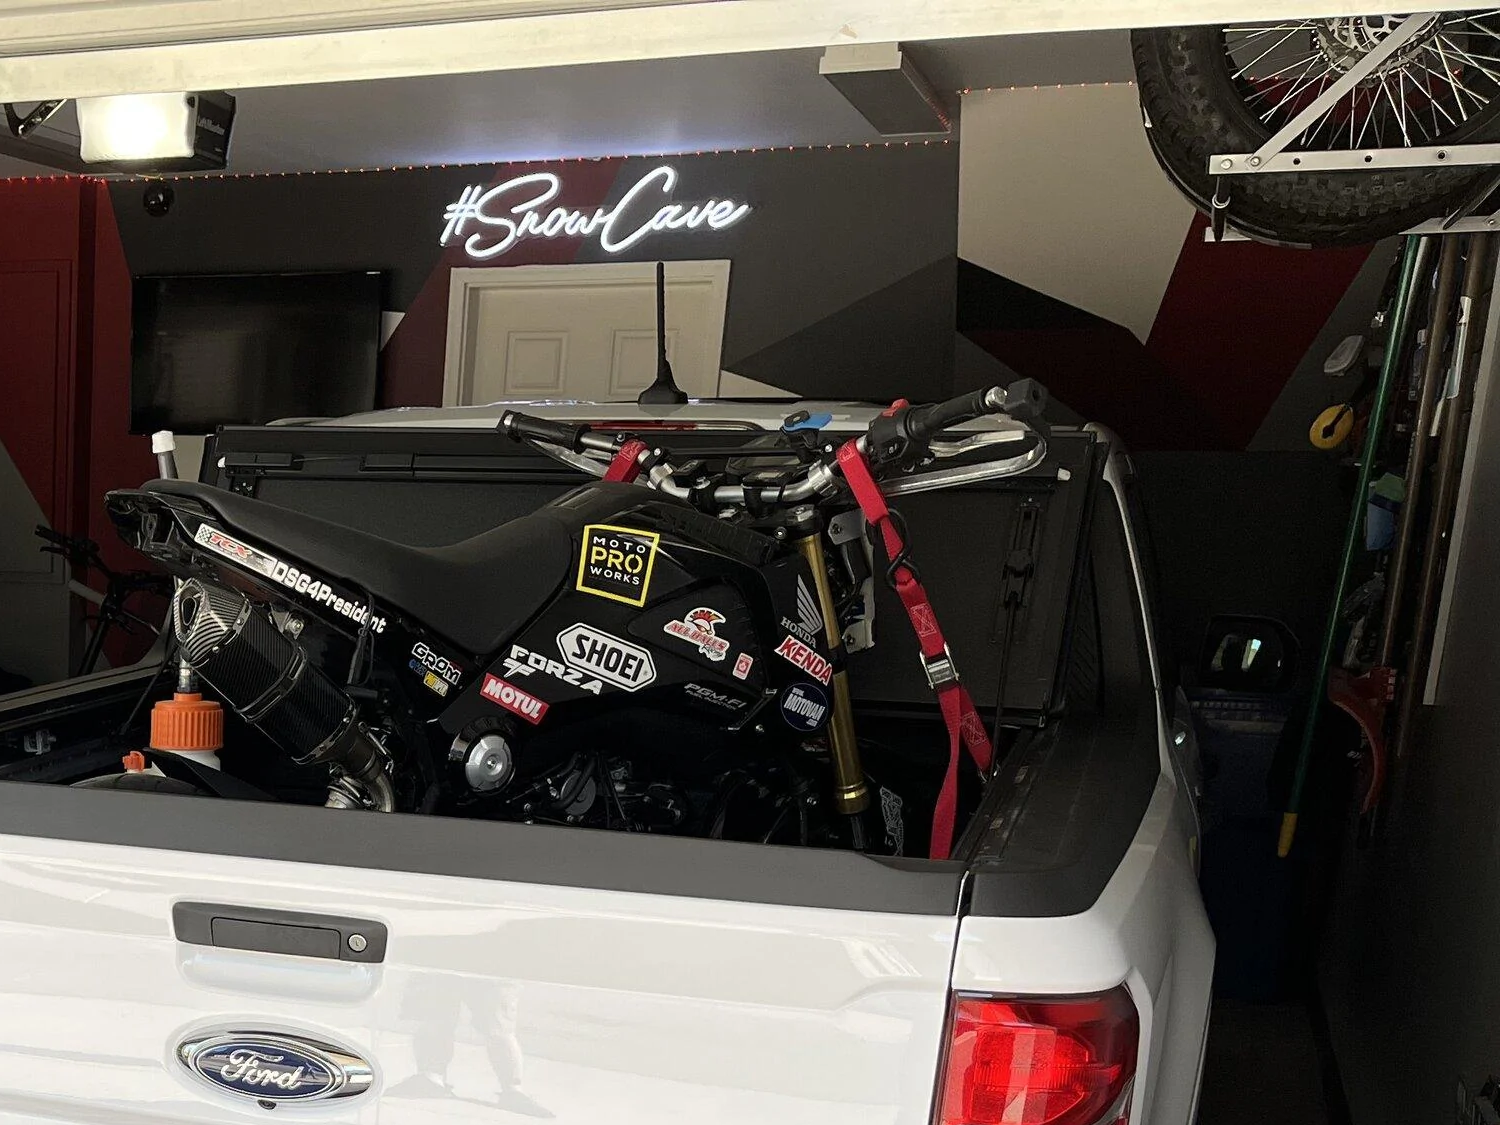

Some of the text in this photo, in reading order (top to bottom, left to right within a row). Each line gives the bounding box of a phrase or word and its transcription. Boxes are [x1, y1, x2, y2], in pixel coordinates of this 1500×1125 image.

[210, 533, 252, 560] TCX
[590, 545, 643, 574] PRO
[592, 535, 646, 554] MOTO
[590, 565, 640, 585] WORKS
[780, 616, 817, 649] HONDA
[411, 641, 462, 685] GROM
[509, 644, 603, 695] FORZA
[572, 634, 645, 683] SHOEI
[776, 636, 833, 685] KENDA
[483, 678, 544, 719] MOTUL
[784, 693, 826, 722] MOTOVAN
[221, 1048, 306, 1090] Ford
